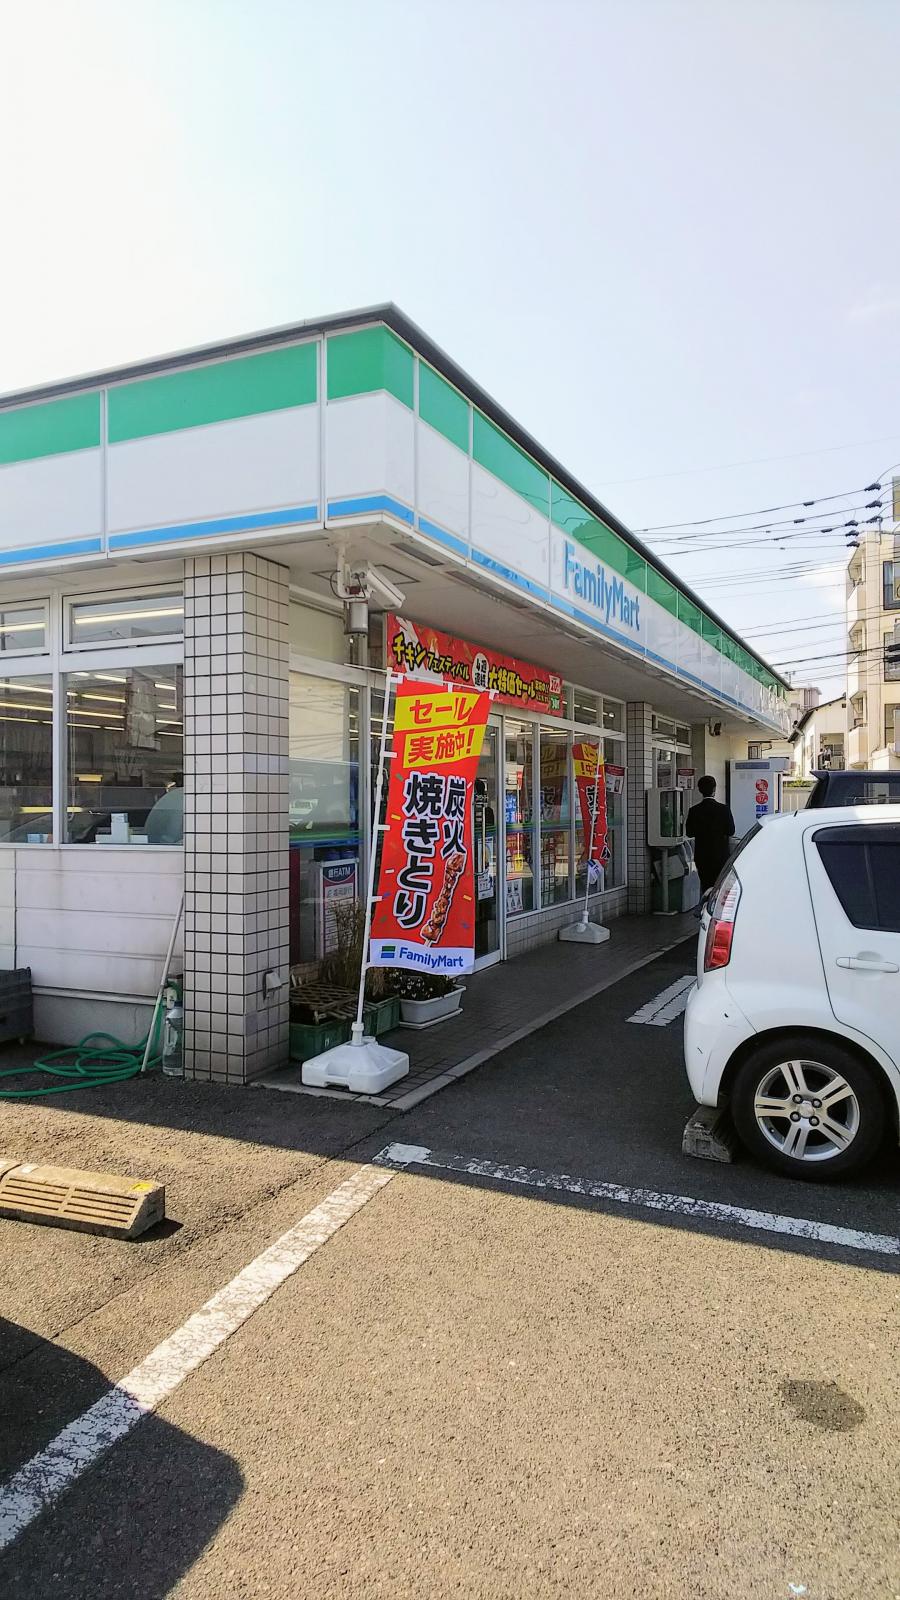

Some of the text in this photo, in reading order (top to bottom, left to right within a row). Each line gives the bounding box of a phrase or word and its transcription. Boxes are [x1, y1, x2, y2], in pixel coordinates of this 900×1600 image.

[564, 540, 640, 631] FamilyMart
[409, 697, 472, 725] セール
[395, 774, 443, 926] 焼きとり
[442, 778, 467, 858] 炭火
[399, 947, 464, 969] FamilyMart
